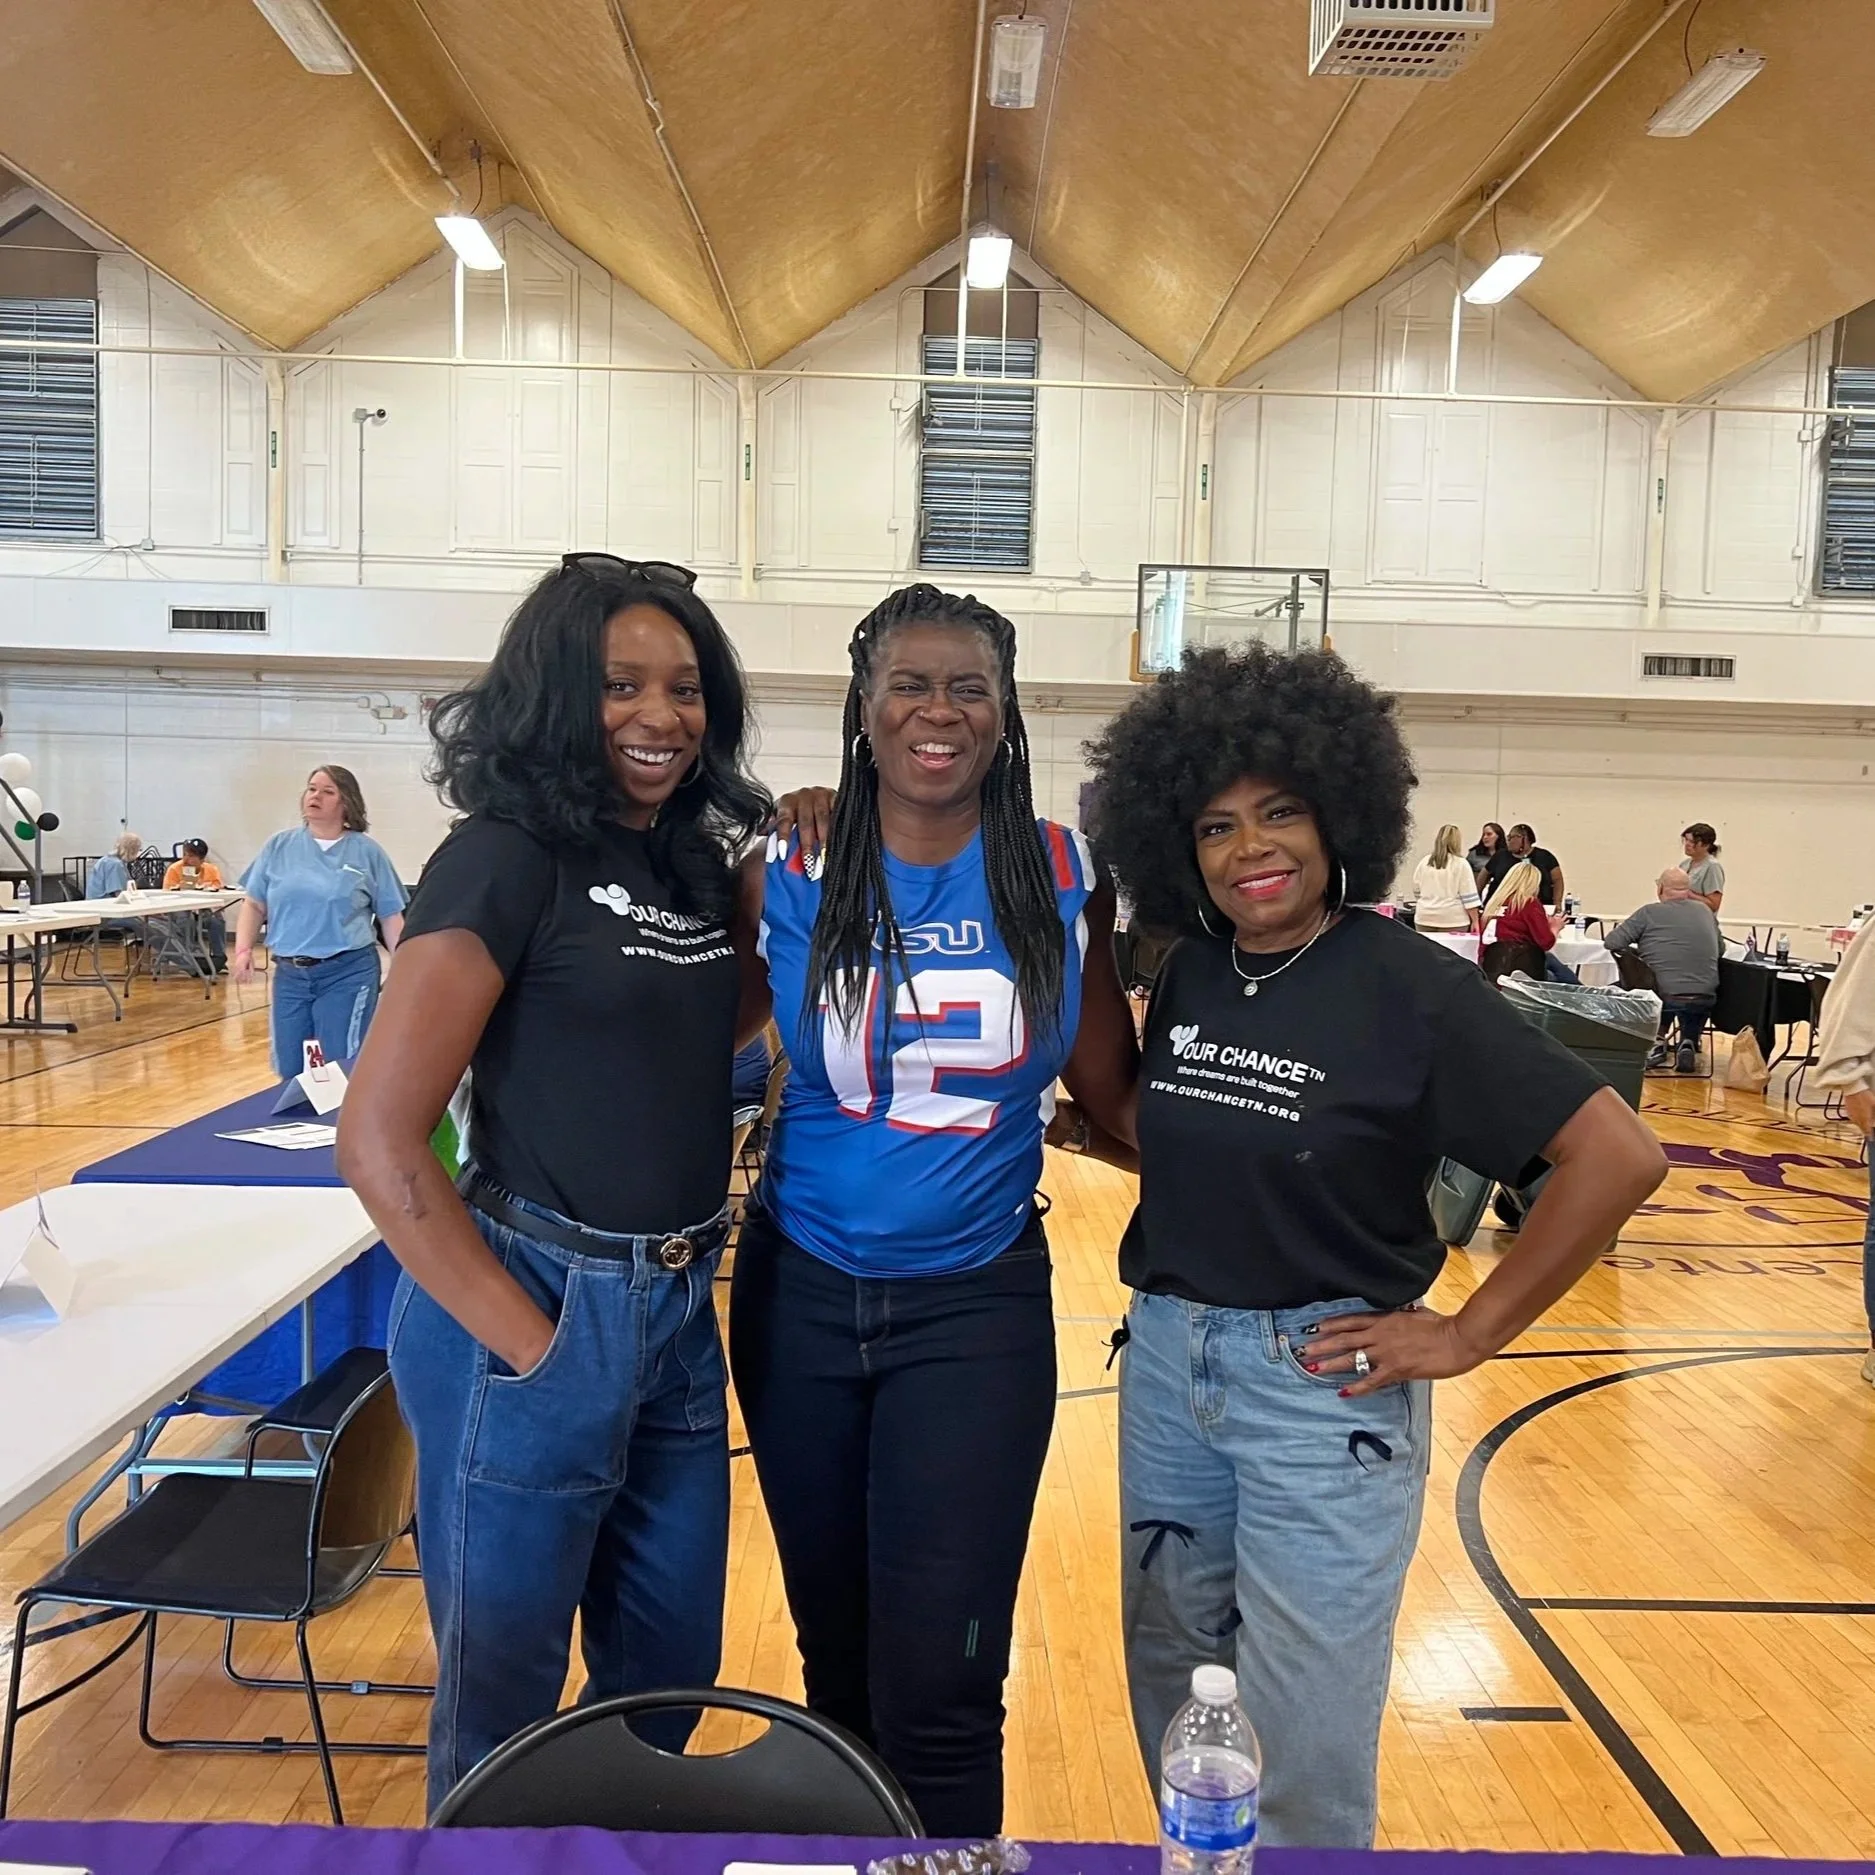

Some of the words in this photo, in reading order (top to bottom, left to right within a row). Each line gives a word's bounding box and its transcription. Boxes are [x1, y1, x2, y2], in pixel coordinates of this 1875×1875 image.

[818, 965, 1029, 1135] 12
[1219, 1046, 1309, 1084] CHANCE
[1309, 1067, 1326, 1082] TN
[1149, 1080, 1301, 1122] WWW.OURCHANCETN.ORG
[1177, 1066, 1198, 1076] Where
[1198, 1068, 1226, 1081] dreams
[1226, 1075, 1240, 1084] are
[1240, 1075, 1257, 1088] built
[1258, 1080, 1300, 1098] together
